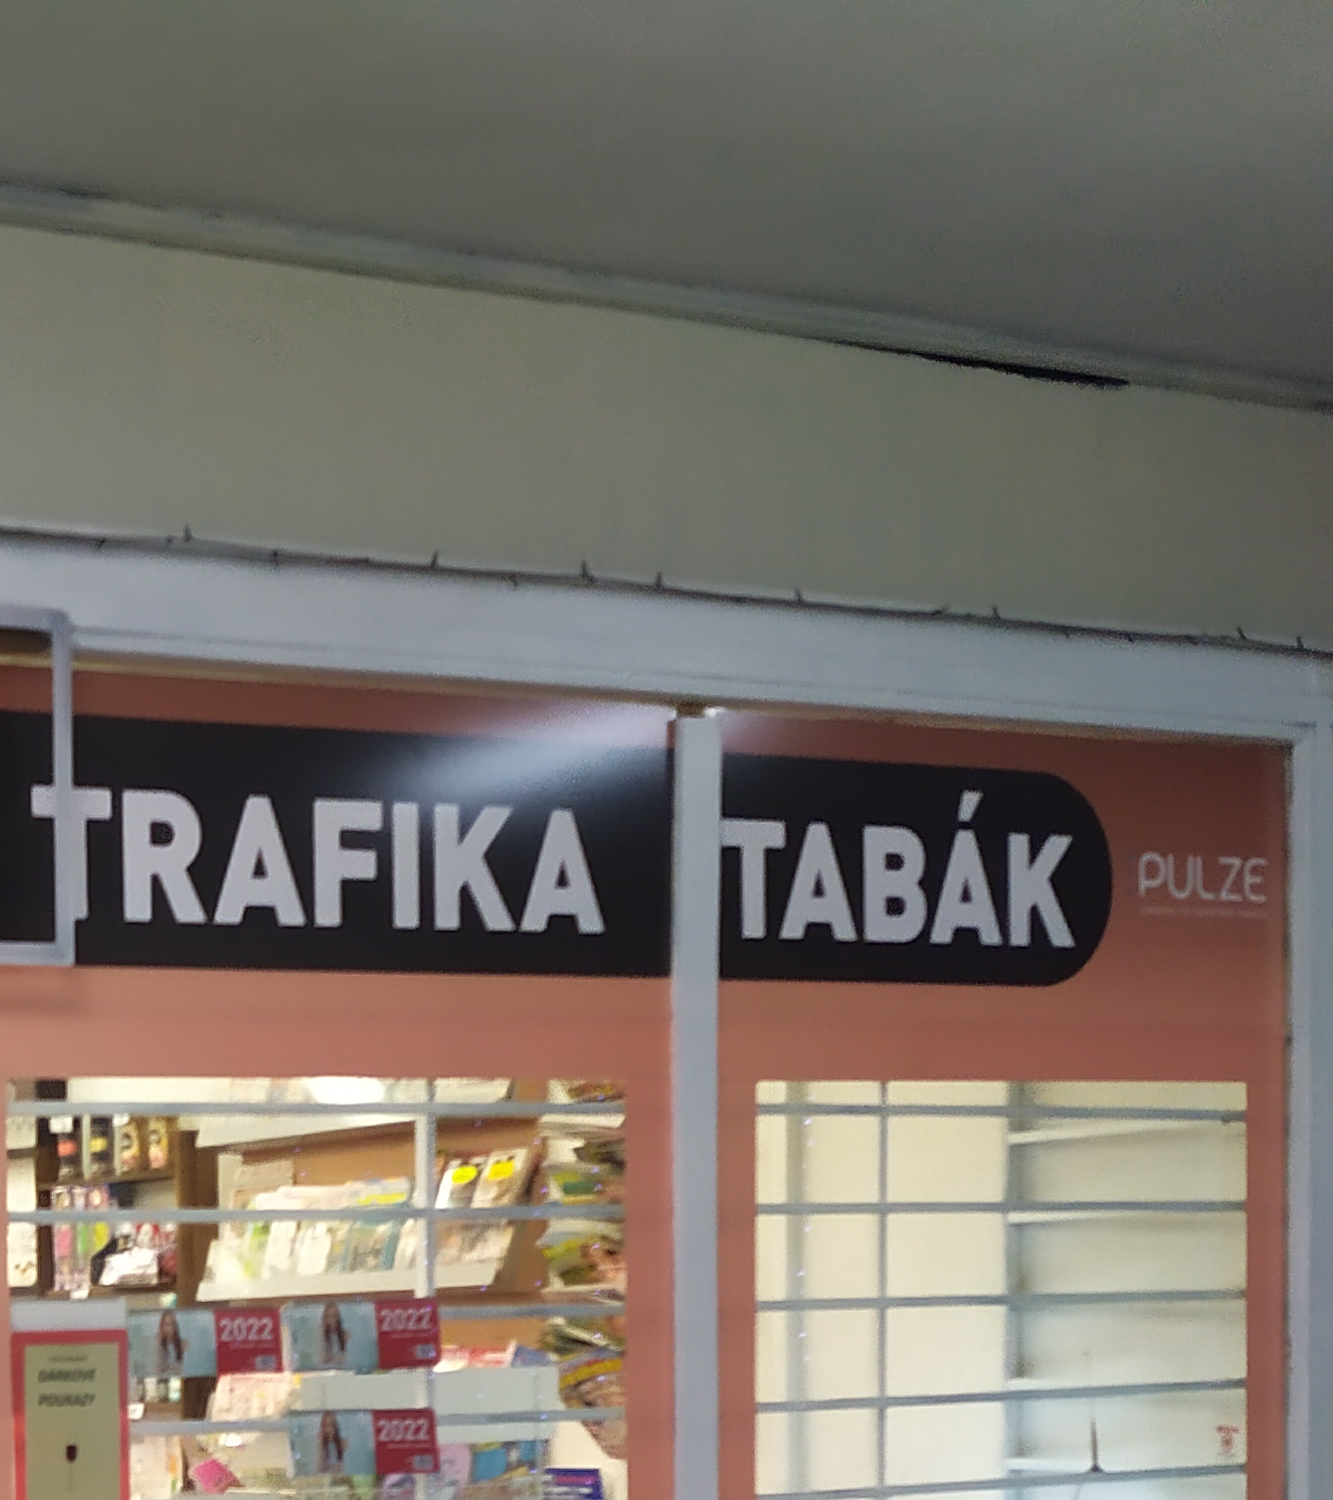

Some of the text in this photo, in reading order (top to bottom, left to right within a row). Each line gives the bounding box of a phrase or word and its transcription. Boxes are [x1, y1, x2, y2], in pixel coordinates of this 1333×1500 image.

[30, 783, 605, 935] TRAFIKA
[721, 790, 1077, 949] TABÁK
[1137, 851, 1269, 904] PULZE
[219, 1317, 273, 1341] 2022
[380, 1308, 431, 1331] 2022
[377, 1418, 430, 1443] 2022
